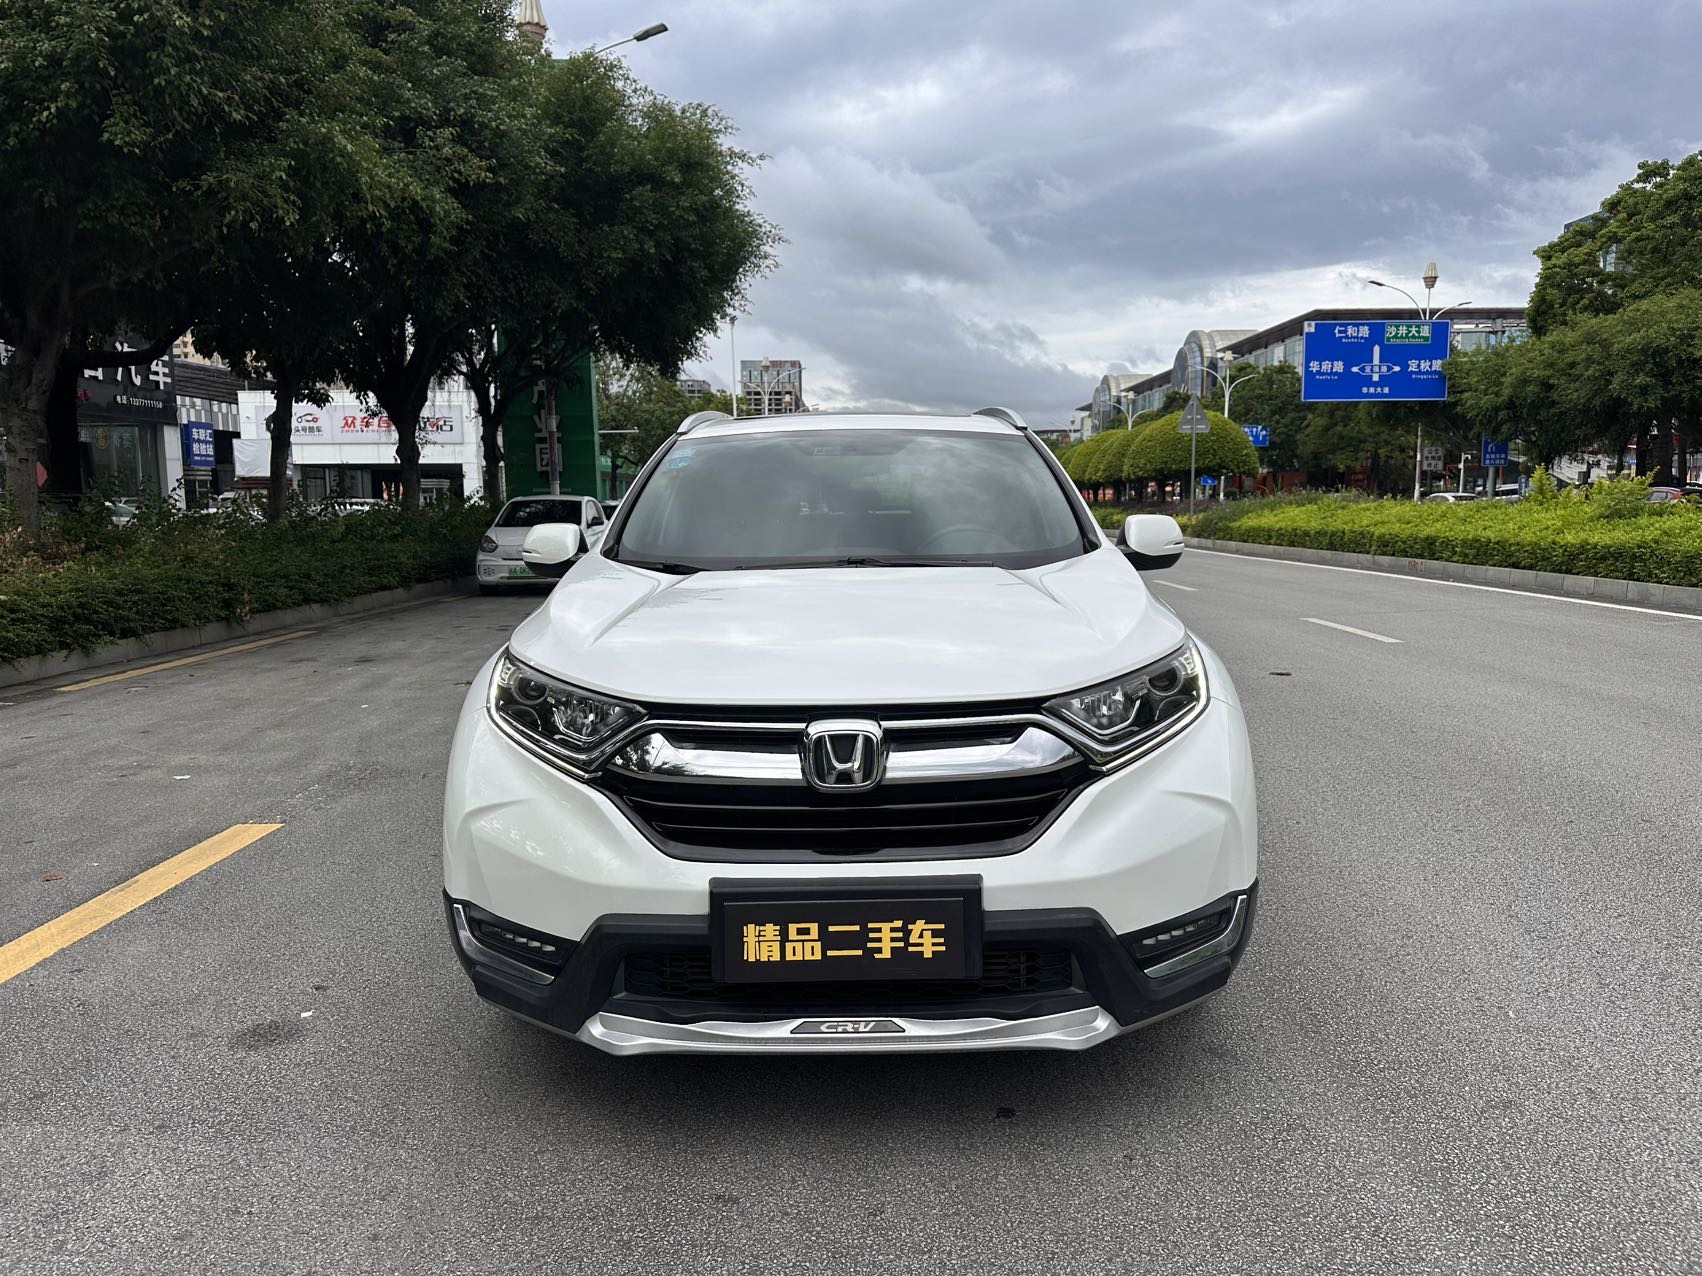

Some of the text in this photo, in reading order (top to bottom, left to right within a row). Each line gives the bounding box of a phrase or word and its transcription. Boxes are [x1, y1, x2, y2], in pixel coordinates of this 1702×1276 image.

[1334, 325, 1370, 338] 仁和路
[1386, 324, 1430, 337] 沙井大道
[1308, 360, 1344, 373] 华府路
[1408, 359, 1443, 372] 定秋路
[191, 427, 213, 441] 车联汇
[192, 442, 214, 456] 检验站
[743, 919, 946, 962] 精品二手车
